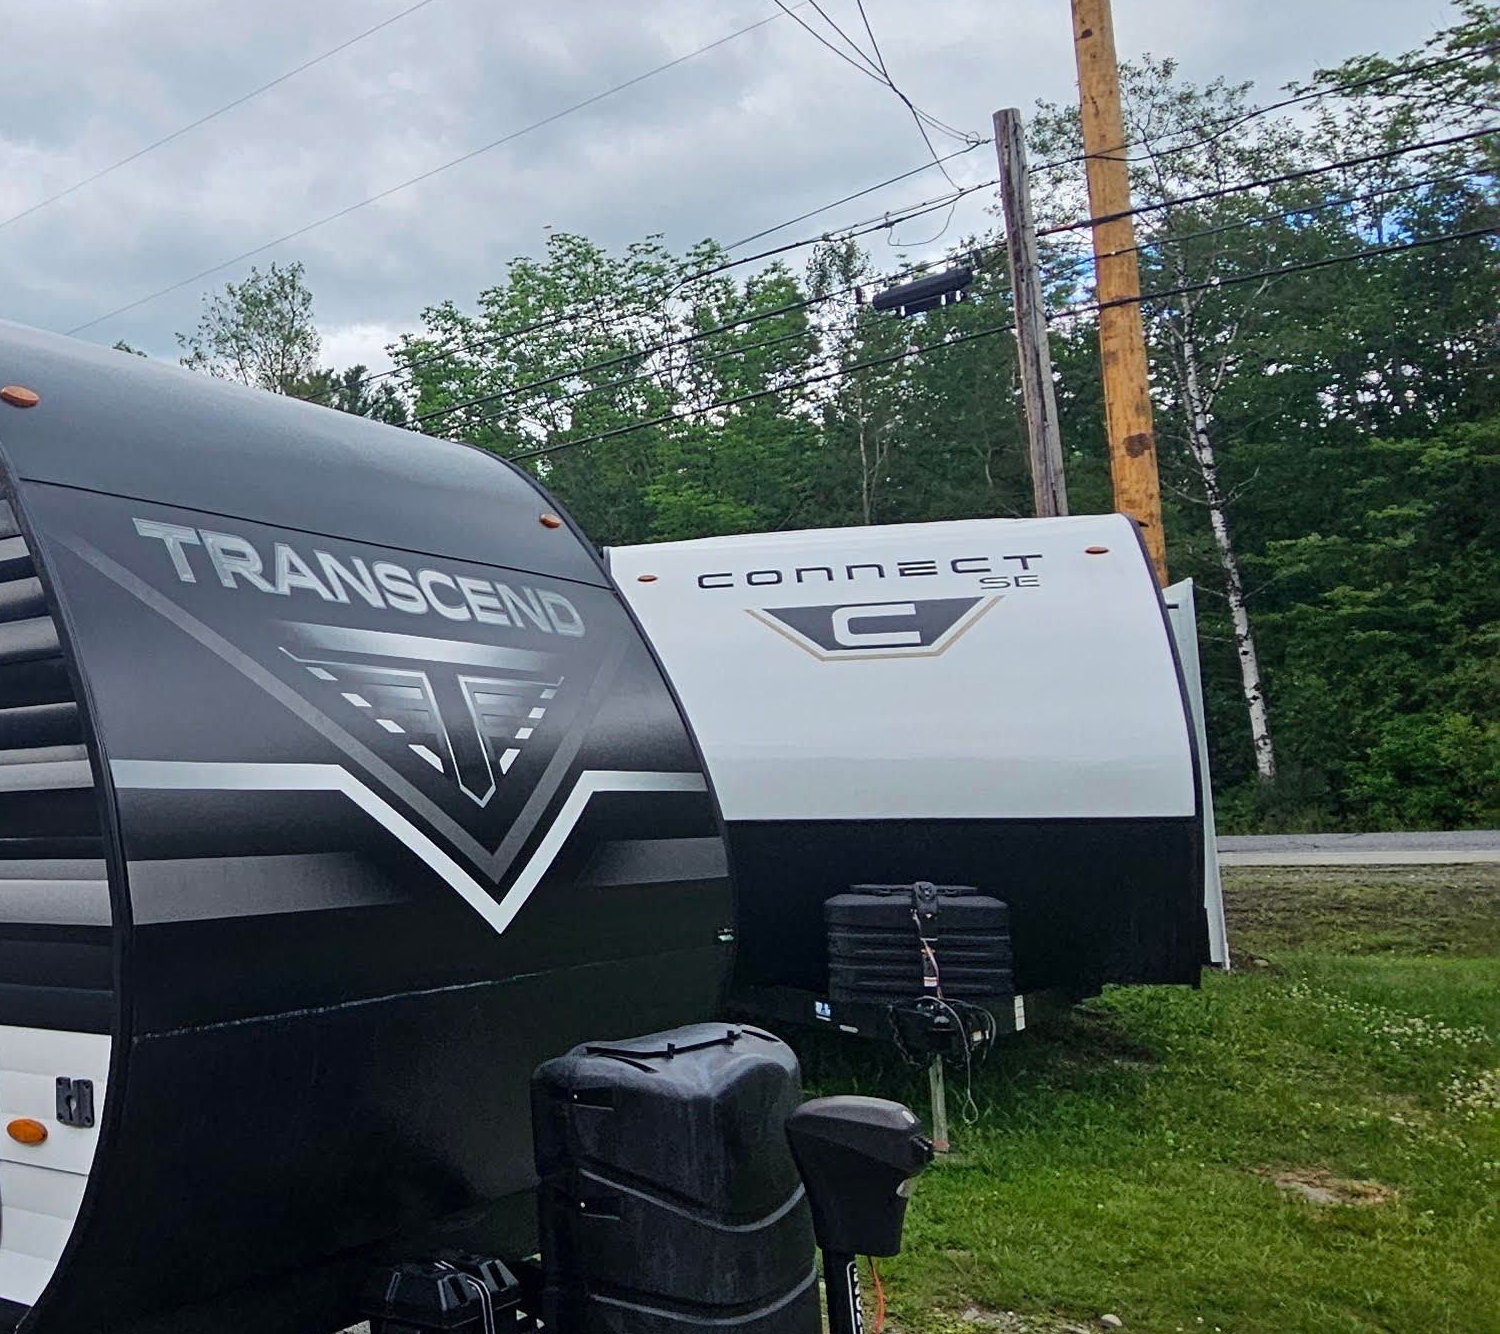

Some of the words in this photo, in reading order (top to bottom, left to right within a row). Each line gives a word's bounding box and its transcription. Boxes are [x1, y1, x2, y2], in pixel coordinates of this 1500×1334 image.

[131, 517, 587, 639] TRANSCEND
[697, 554, 1043, 590] CONNECT
[979, 575, 1041, 590] SE
